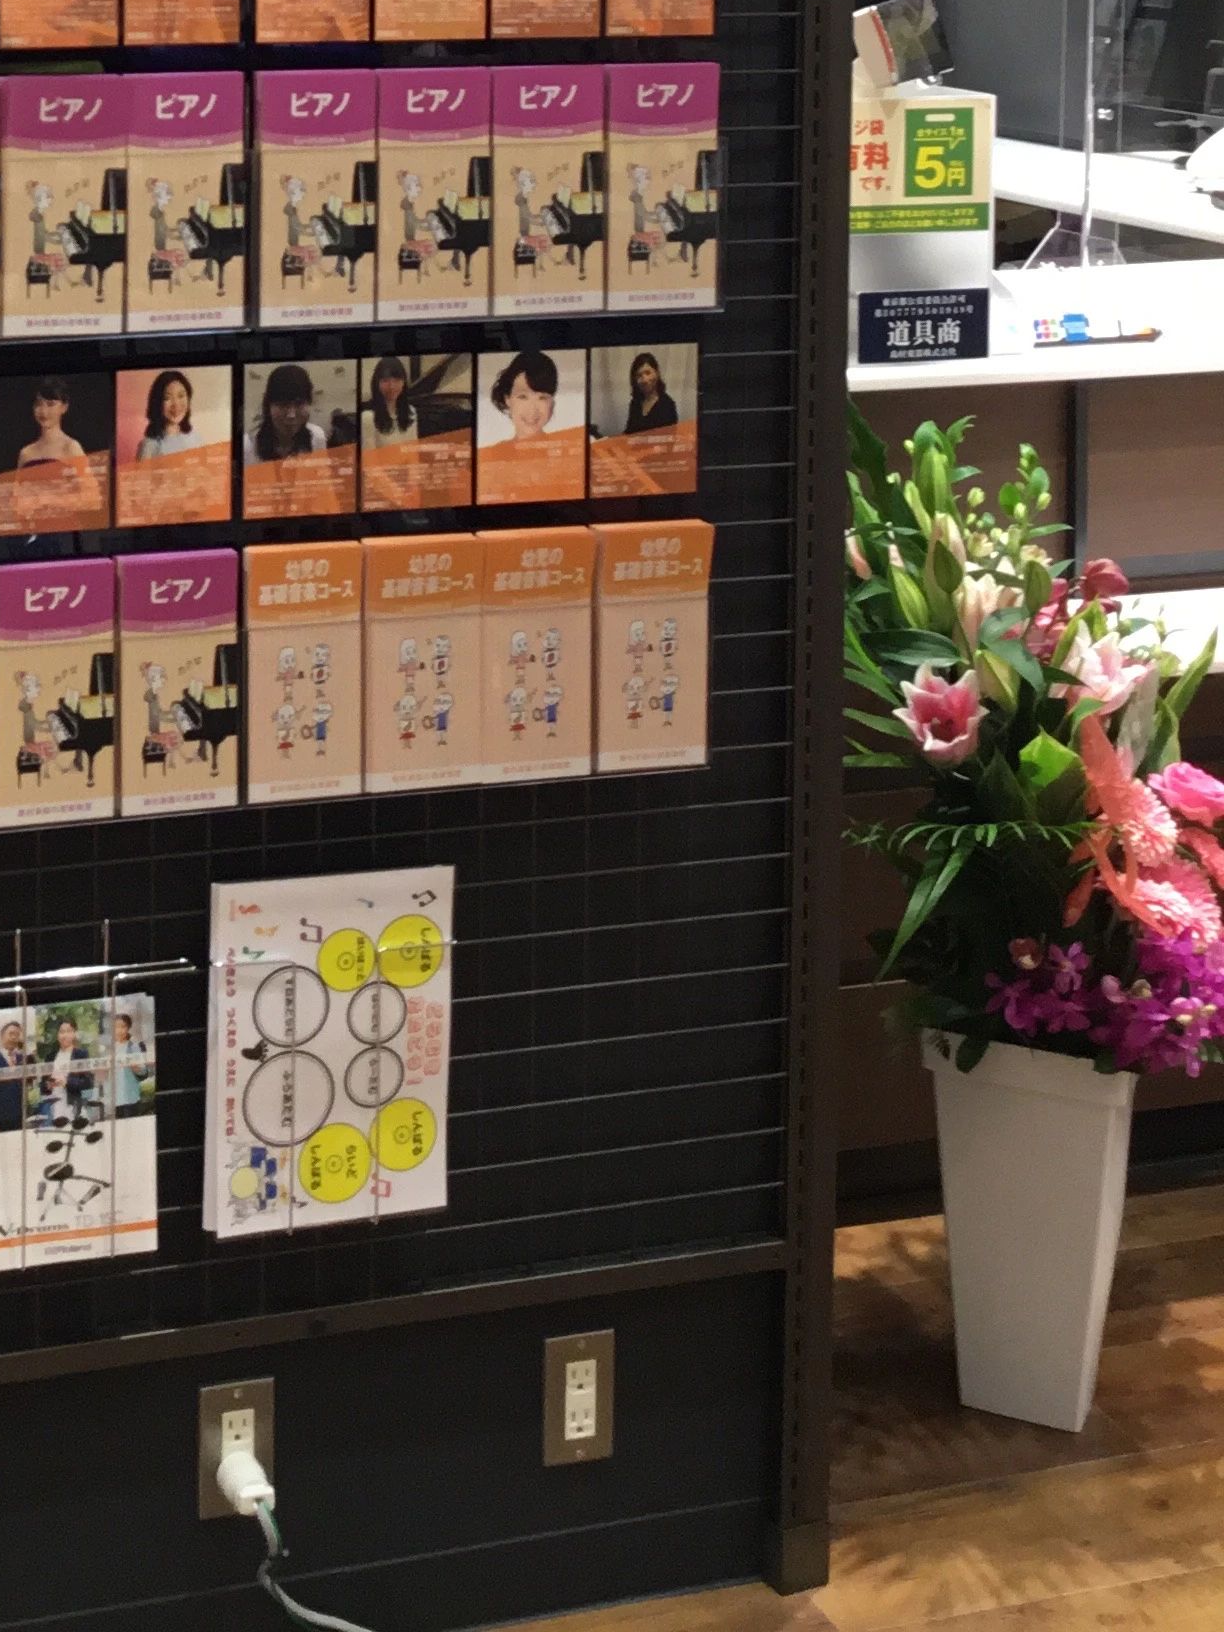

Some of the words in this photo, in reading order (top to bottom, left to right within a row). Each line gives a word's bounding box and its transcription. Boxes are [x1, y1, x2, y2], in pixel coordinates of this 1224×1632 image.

[155, 93, 217, 120] ピアノ
[290, 92, 351, 118] ピアノ
[407, 88, 465, 114] ピアノ
[520, 84, 578, 111] ピアノ
[636, 82, 694, 109] ピアノ
[39, 96, 103, 123] ピアノ
[914, 146, 965, 188] 5円
[886, 318, 962, 346] 道具商
[520, 548, 563, 568] 幼児の
[639, 538, 681, 558] 幼児の
[284, 558, 329, 580] 幼児の
[408, 553, 452, 574] 幼児の
[25, 585, 88, 613] ピアノ
[150, 578, 211, 605] ピアノ
